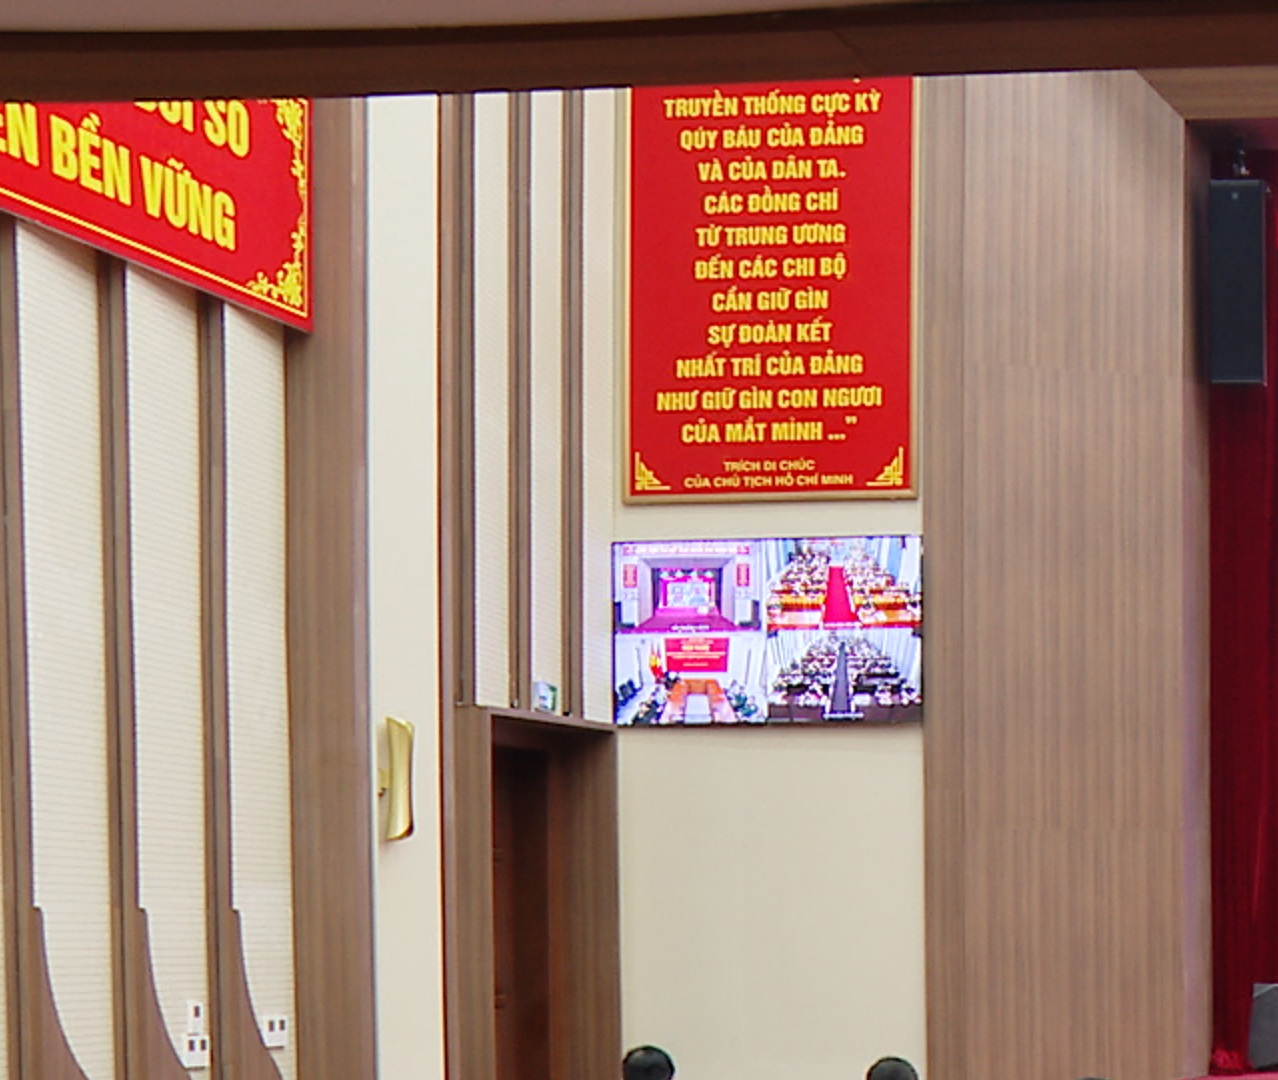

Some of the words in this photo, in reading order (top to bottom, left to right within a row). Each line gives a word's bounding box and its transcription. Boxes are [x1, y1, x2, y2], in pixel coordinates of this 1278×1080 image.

[742, 89, 807, 116] THỐNG
[810, 92, 851, 118] CỰC
[854, 88, 882, 113] KỲ
[722, 124, 762, 149] BÁU
[766, 122, 806, 148] CỦA
[809, 119, 864, 147] ĐẢNG
[50, 112, 131, 206] BỀN
[139, 157, 236, 251] VỮNG
[697, 158, 724, 182] VÀ
[728, 155, 768, 181] CỦA
[771, 154, 813, 180] DÂN
[816, 158, 847, 179] TA.
[704, 190, 744, 215] CÁC
[747, 185, 801, 213] ĐỒNG
[805, 187, 839, 212] CHÍ
[695, 223, 723, 247] TỪ
[723, 225, 788, 247] TRUNG
[792, 222, 846, 245] ƯƠNG
[694, 253, 734, 280] ĐẾN
[738, 254, 778, 279] CÁC
[782, 257, 816, 278] CHI
[819, 252, 847, 280] BỘ
[756, 287, 792, 311] GIỮ
[794, 286, 829, 310] GÌN
[707, 323, 737, 349] SỰ
[738, 319, 792, 344] ĐOÀN
[796, 315, 833, 343] KẾT
[676, 351, 727, 379] NHẤT
[730, 353, 762, 377] TRÍ
[766, 349, 806, 376] CỦA
[809, 348, 864, 375] ĐẢNG
[656, 389, 700, 411] NHƯ
[701, 387, 737, 410] GIỮ
[738, 385, 773, 410] GÌN
[777, 388, 818, 409] CON
[681, 417, 721, 444] CỦA
[771, 417, 823, 442] MÌNH
